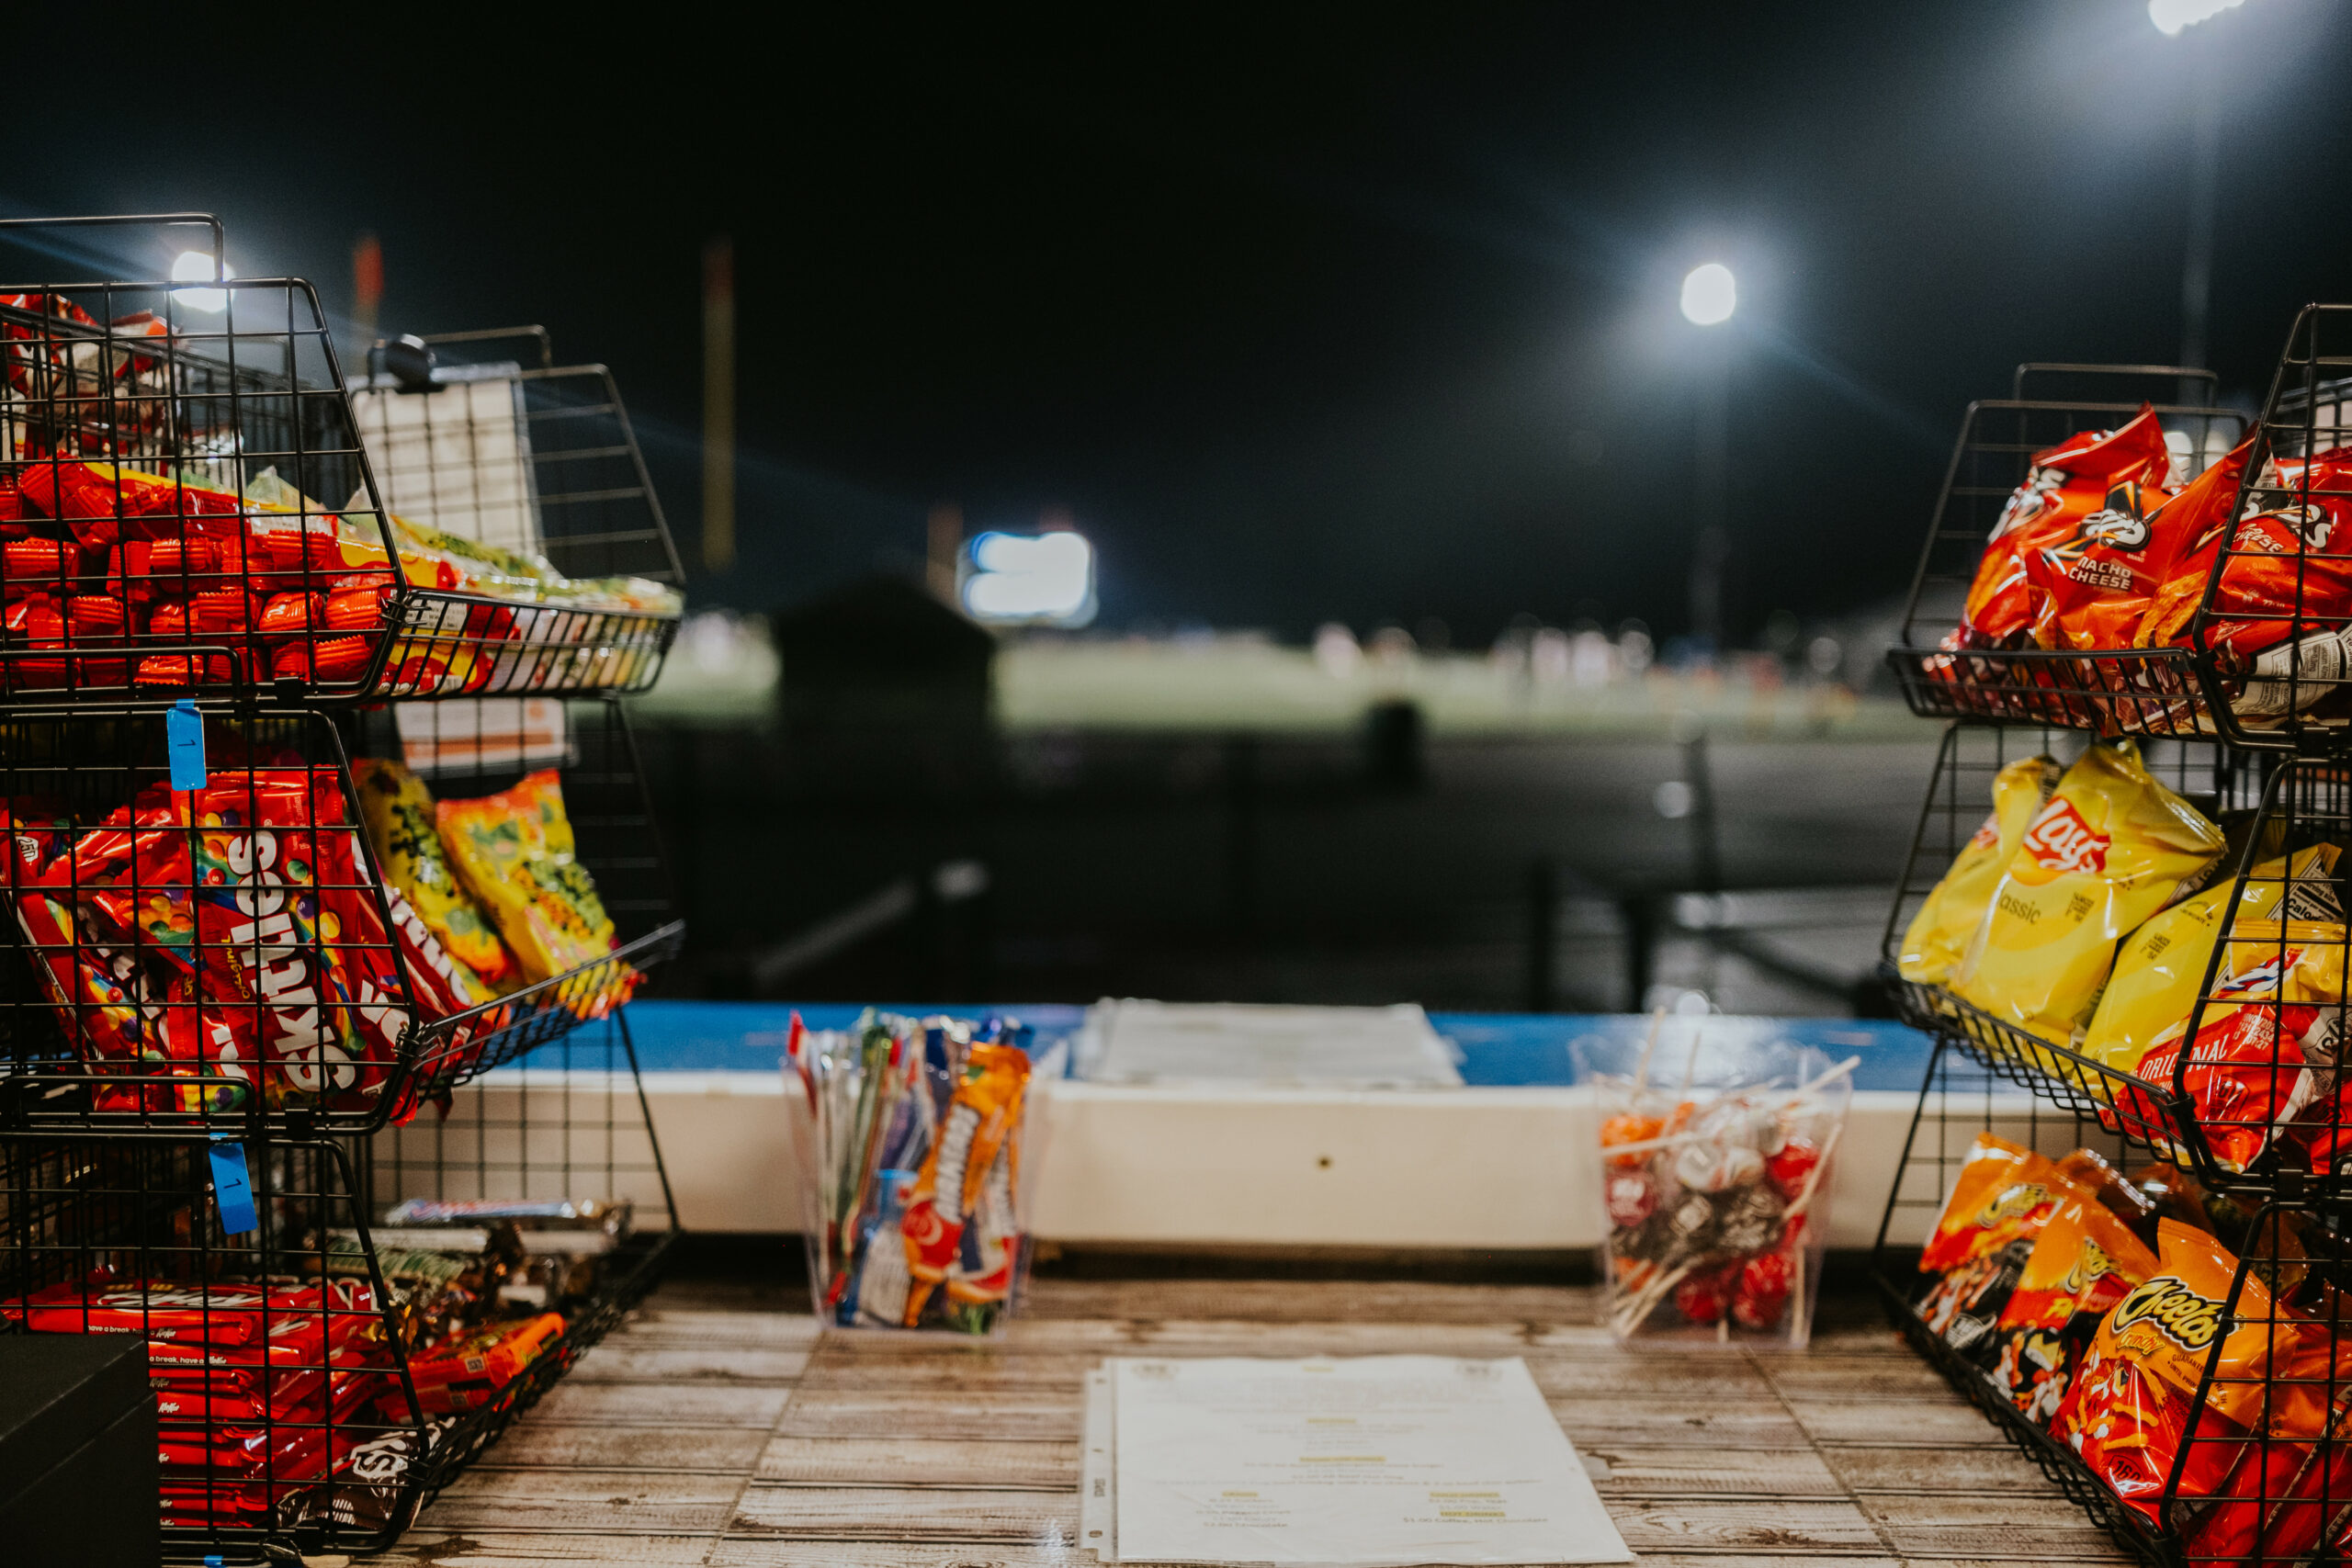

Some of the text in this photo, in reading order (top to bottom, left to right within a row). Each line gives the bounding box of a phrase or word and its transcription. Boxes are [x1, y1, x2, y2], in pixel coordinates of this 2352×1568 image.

[2068, 567, 2132, 590] CHEESE
[2077, 556, 2132, 579] NACHO
[176, 739, 197, 748] 1
[1999, 891, 2041, 924] assic
[227, 829, 356, 1093] Skittles
[2141, 1034, 2229, 1081] ORIGNAL
[223, 1178, 243, 1189] 1
[2113, 1277, 2228, 1348] Cheetos
[2117, 1329, 2165, 1356] Crunchy
[2172, 1354, 2205, 1373] GUARANTEE
[2113, 1460, 2142, 1483] 160
